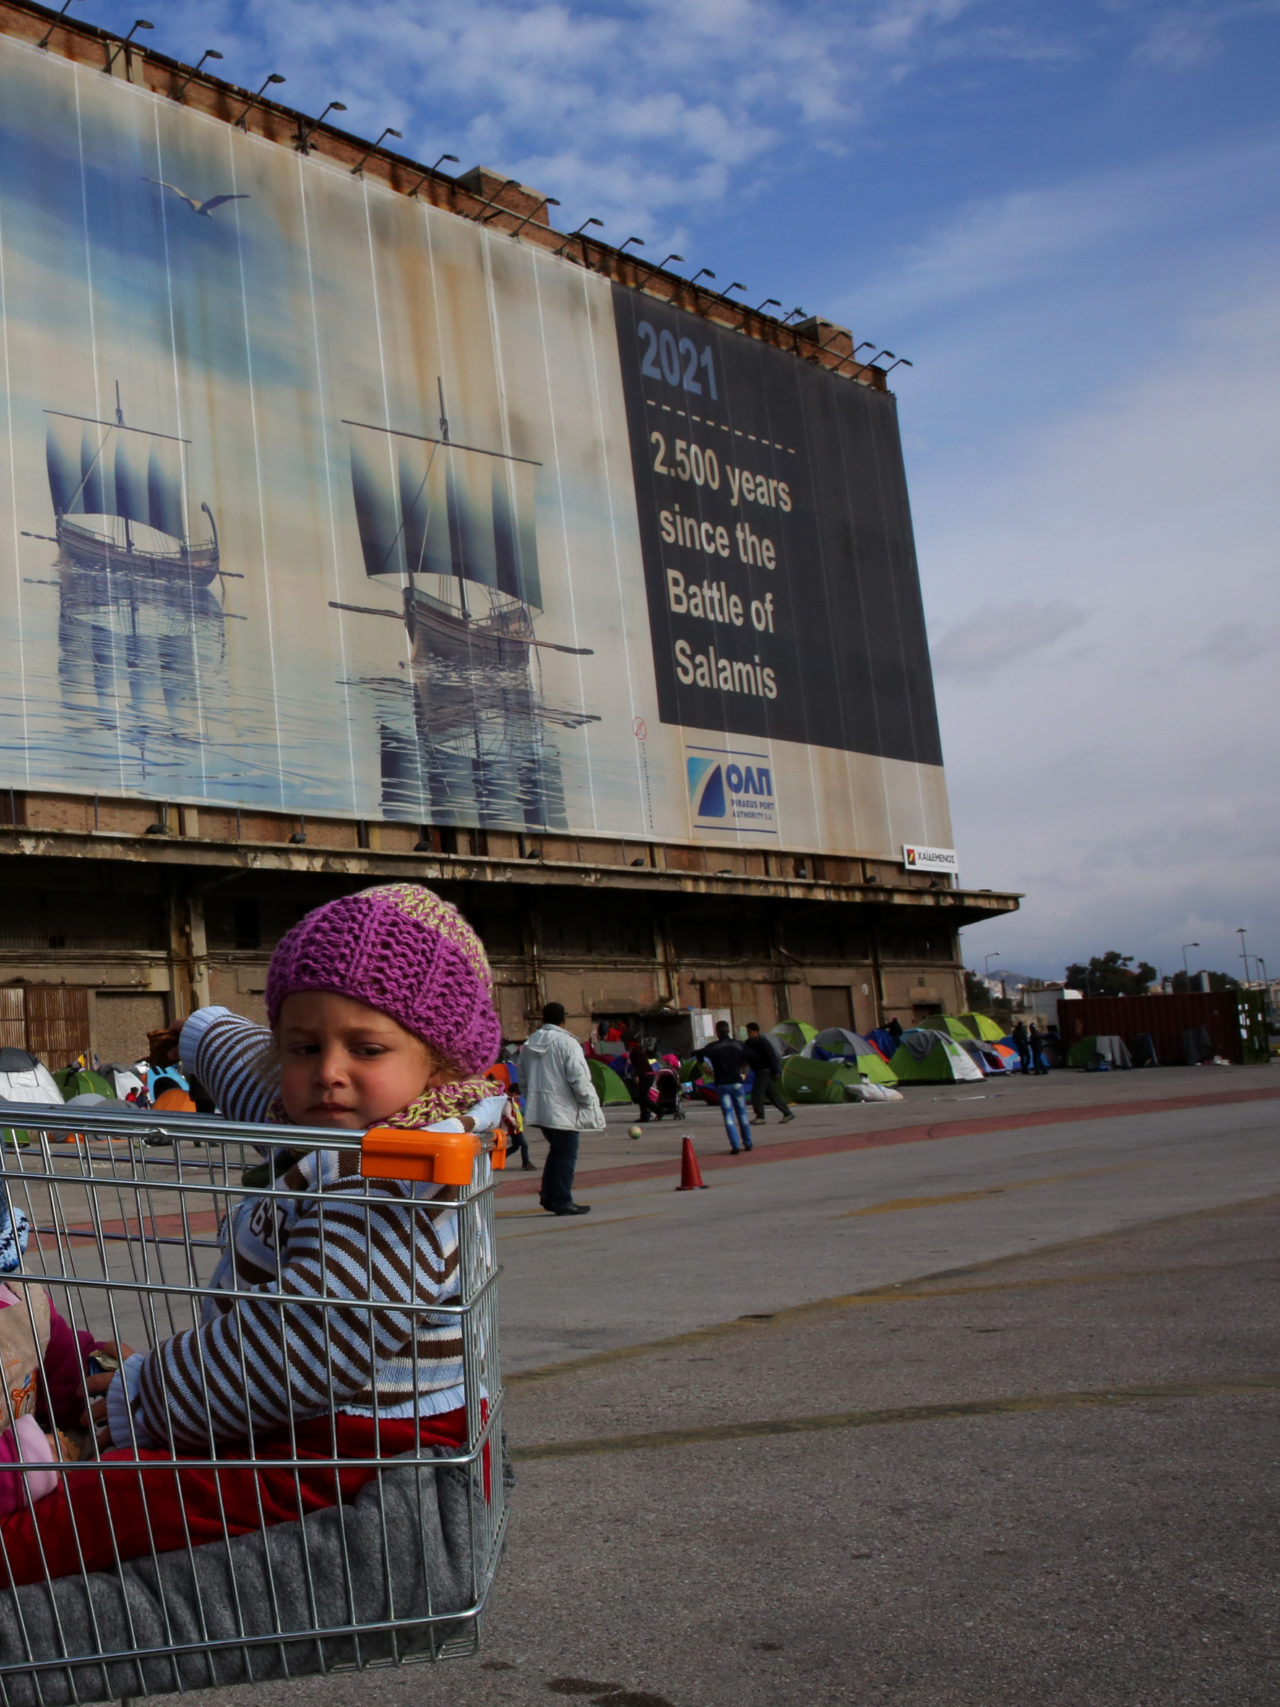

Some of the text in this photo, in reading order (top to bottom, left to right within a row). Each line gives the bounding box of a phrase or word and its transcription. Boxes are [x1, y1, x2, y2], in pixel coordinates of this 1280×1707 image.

[637, 321, 718, 400] 2021
[650, 431, 792, 512] 2.500 years
[659, 504, 776, 570] since the
[667, 569, 774, 633] Battle of
[674, 640, 778, 700] Salamis
[731, 799, 757, 808] PIRAEUS
